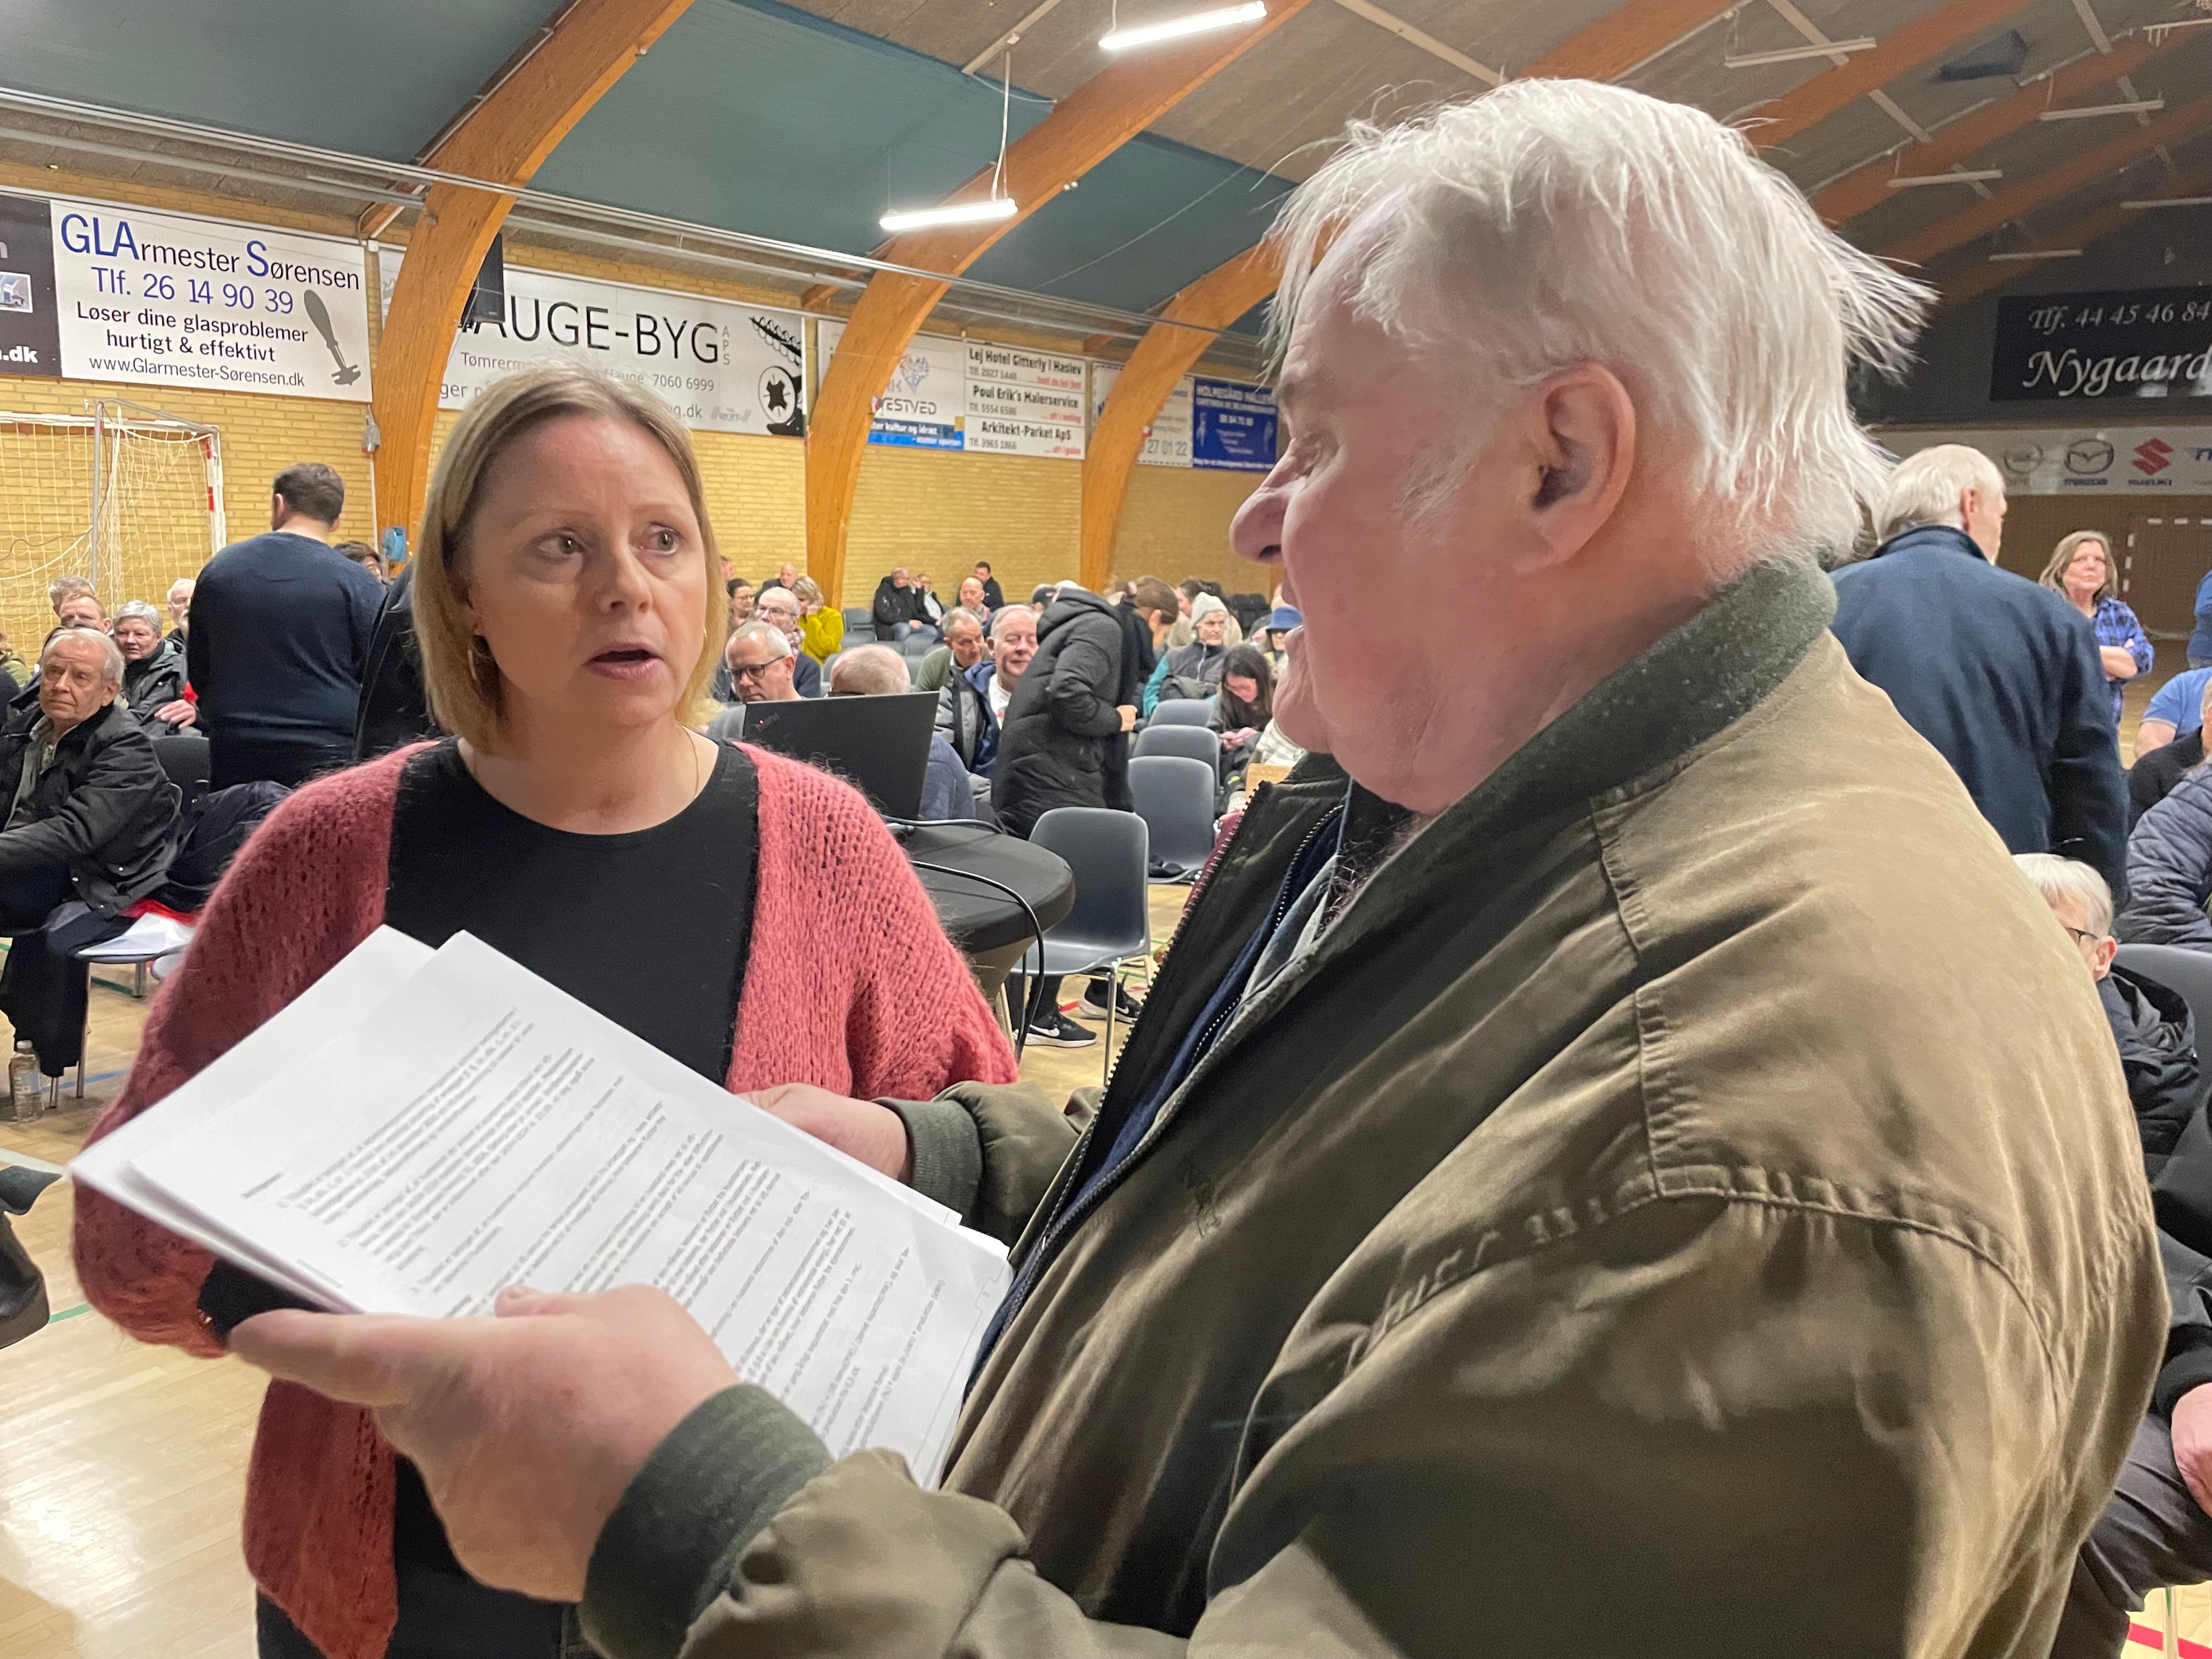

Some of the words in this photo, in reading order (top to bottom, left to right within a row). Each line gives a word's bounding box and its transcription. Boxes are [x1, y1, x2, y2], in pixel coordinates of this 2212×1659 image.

[61, 213, 240, 273] GLArmester
[246, 240, 359, 290] Sørensen
[91, 267, 131, 295] Tlf.
[143, 273, 175, 300] 26
[188, 279, 213, 304] 14
[223, 283, 254, 309] 90
[265, 289, 294, 314] 39
[77, 301, 131, 323] Løser
[138, 308, 177, 328] dine
[184, 314, 308, 342] glasproblemer
[2109, 304, 2140, 325] 45
[2146, 303, 2174, 324] 46
[0, 345, 38, 363] .dk
[106, 329, 173, 354] hurtigt
[179, 336, 194, 354] &
[200, 340, 275, 362] effektivt
[986, 351, 1011, 365] Hotel
[89, 357, 305, 387] www.Glarmester-Sørensen.dk
[652, 374, 681, 389] 7060
[686, 377, 714, 392] 6999
[973, 385, 995, 398] Poul
[1147, 438, 1160, 454] 27
[1162, 439, 1173, 455] 01
[1176, 441, 1188, 456] 22
